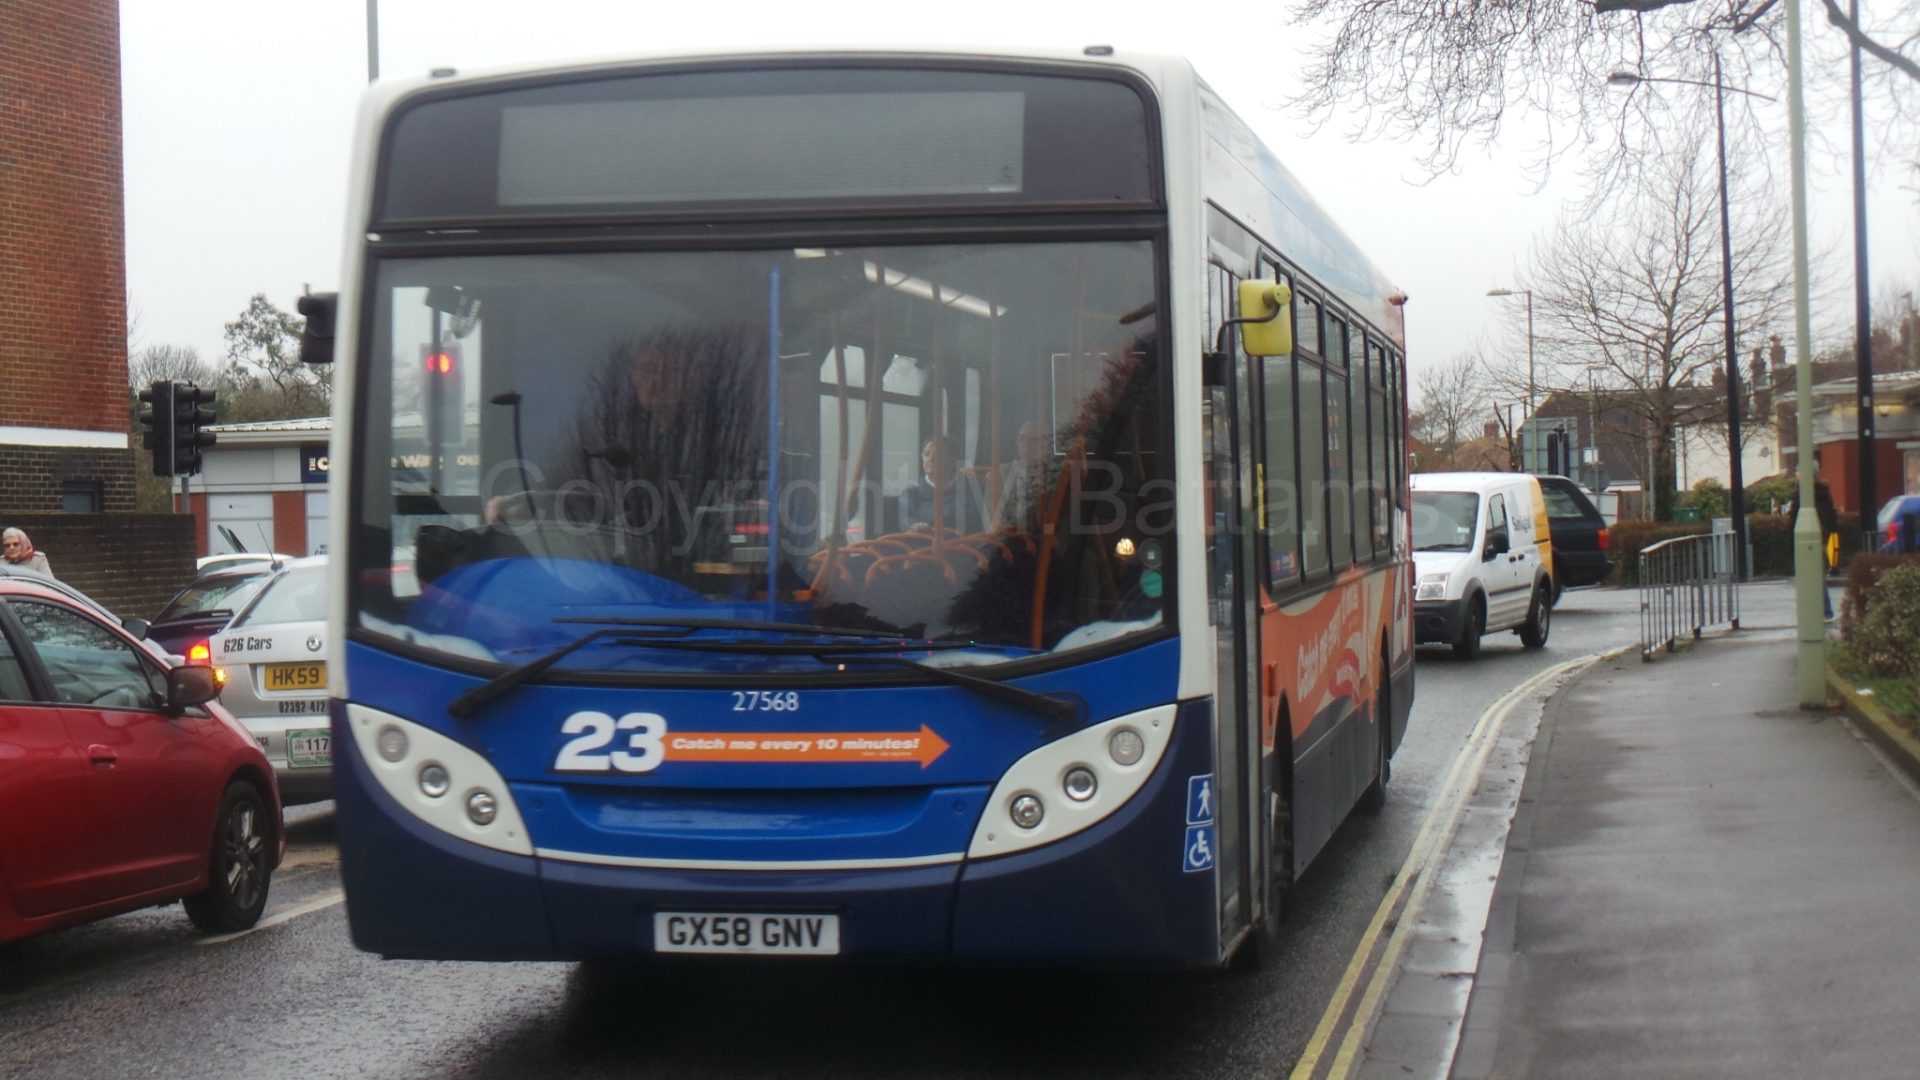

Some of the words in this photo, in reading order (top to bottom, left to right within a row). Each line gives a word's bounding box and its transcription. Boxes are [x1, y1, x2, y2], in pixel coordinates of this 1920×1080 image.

[223, 638, 244, 653] 626
[246, 636, 273, 651] Cars
[272, 667, 320, 686] HK59
[731, 690, 800, 712] 27568
[554, 710, 668, 773] 23
[672, 737, 726, 750] Catch
[729, 740, 757, 750] me
[760, 739, 812, 752] every
[816, 738, 838, 750] 10
[841, 737, 920, 750] minutes!
[667, 915, 753, 947] GX58
[761, 917, 825, 948] GNV
